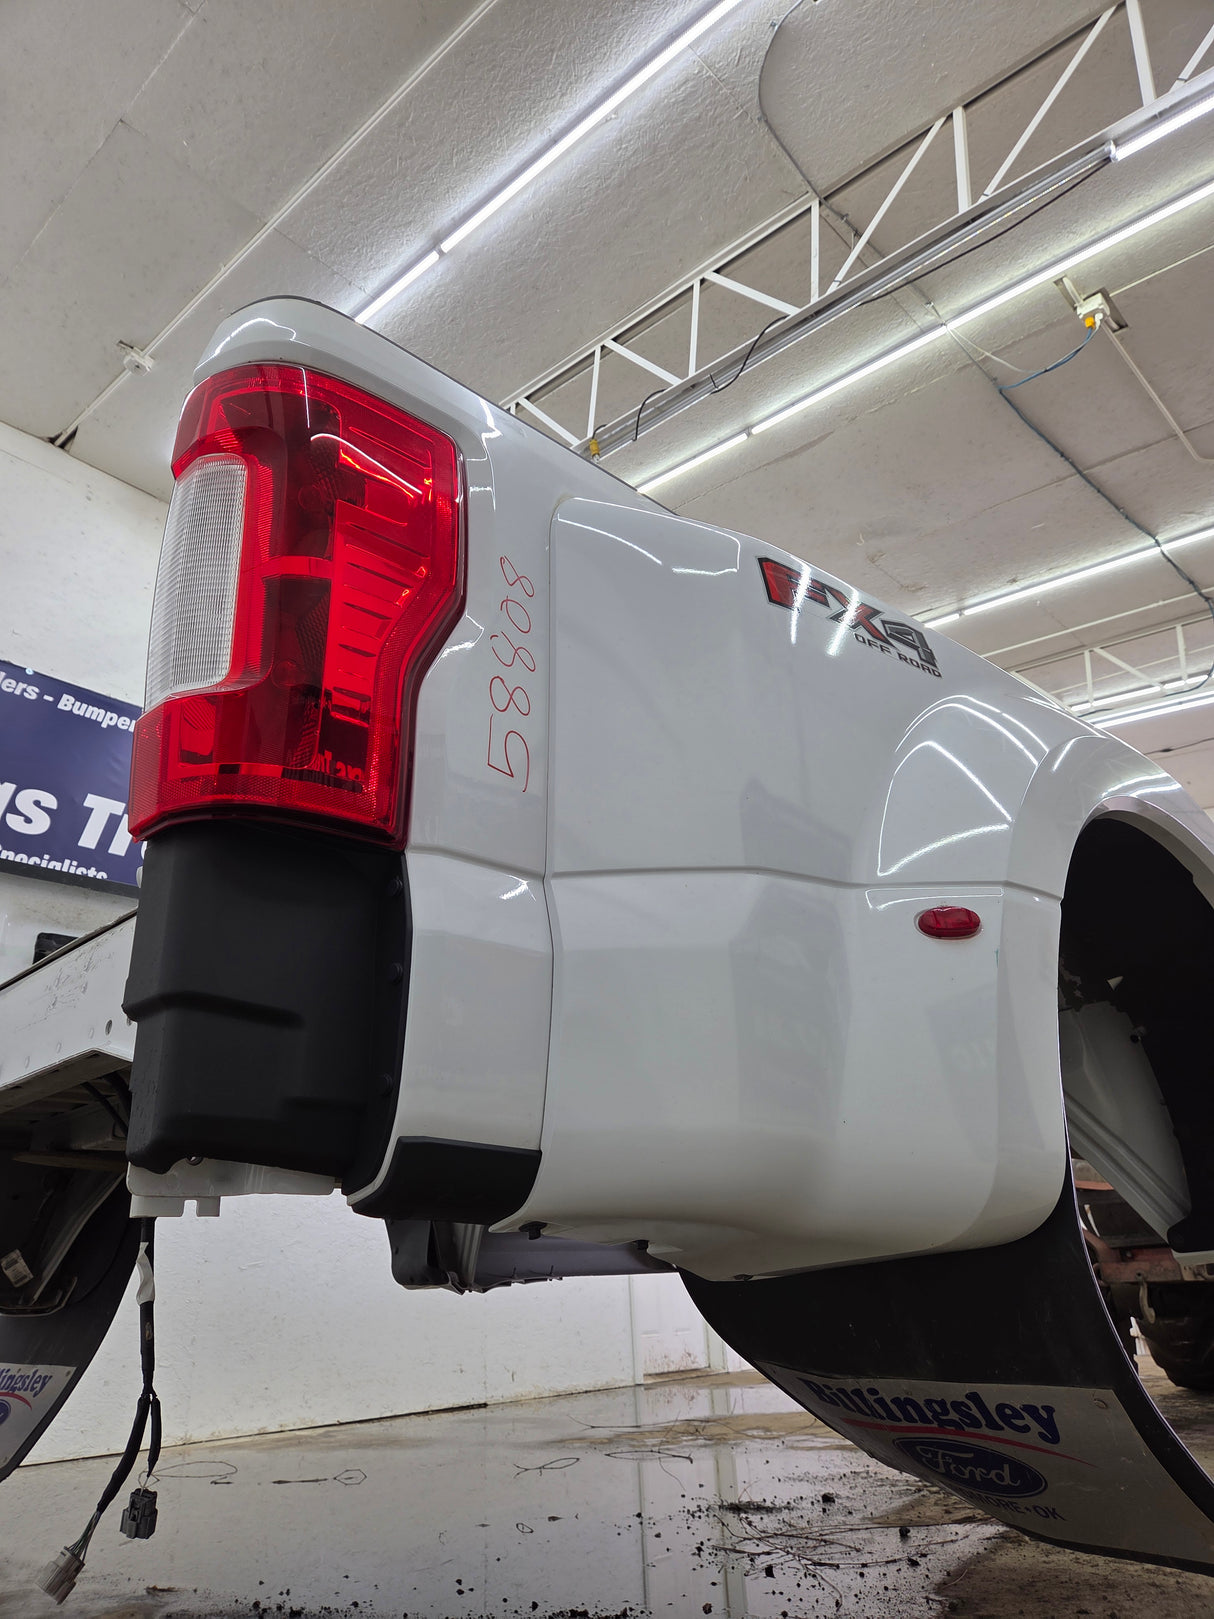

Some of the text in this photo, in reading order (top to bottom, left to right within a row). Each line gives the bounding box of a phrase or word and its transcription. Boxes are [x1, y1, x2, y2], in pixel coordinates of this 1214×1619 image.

[757, 556, 938, 670] FX4
[854, 632, 943, 678] OFF ROAD
[796, 1376, 1062, 1445] Billingsley
[915, 1444, 1021, 1488] Ford
[1032, 1504, 1068, 1522] OK
